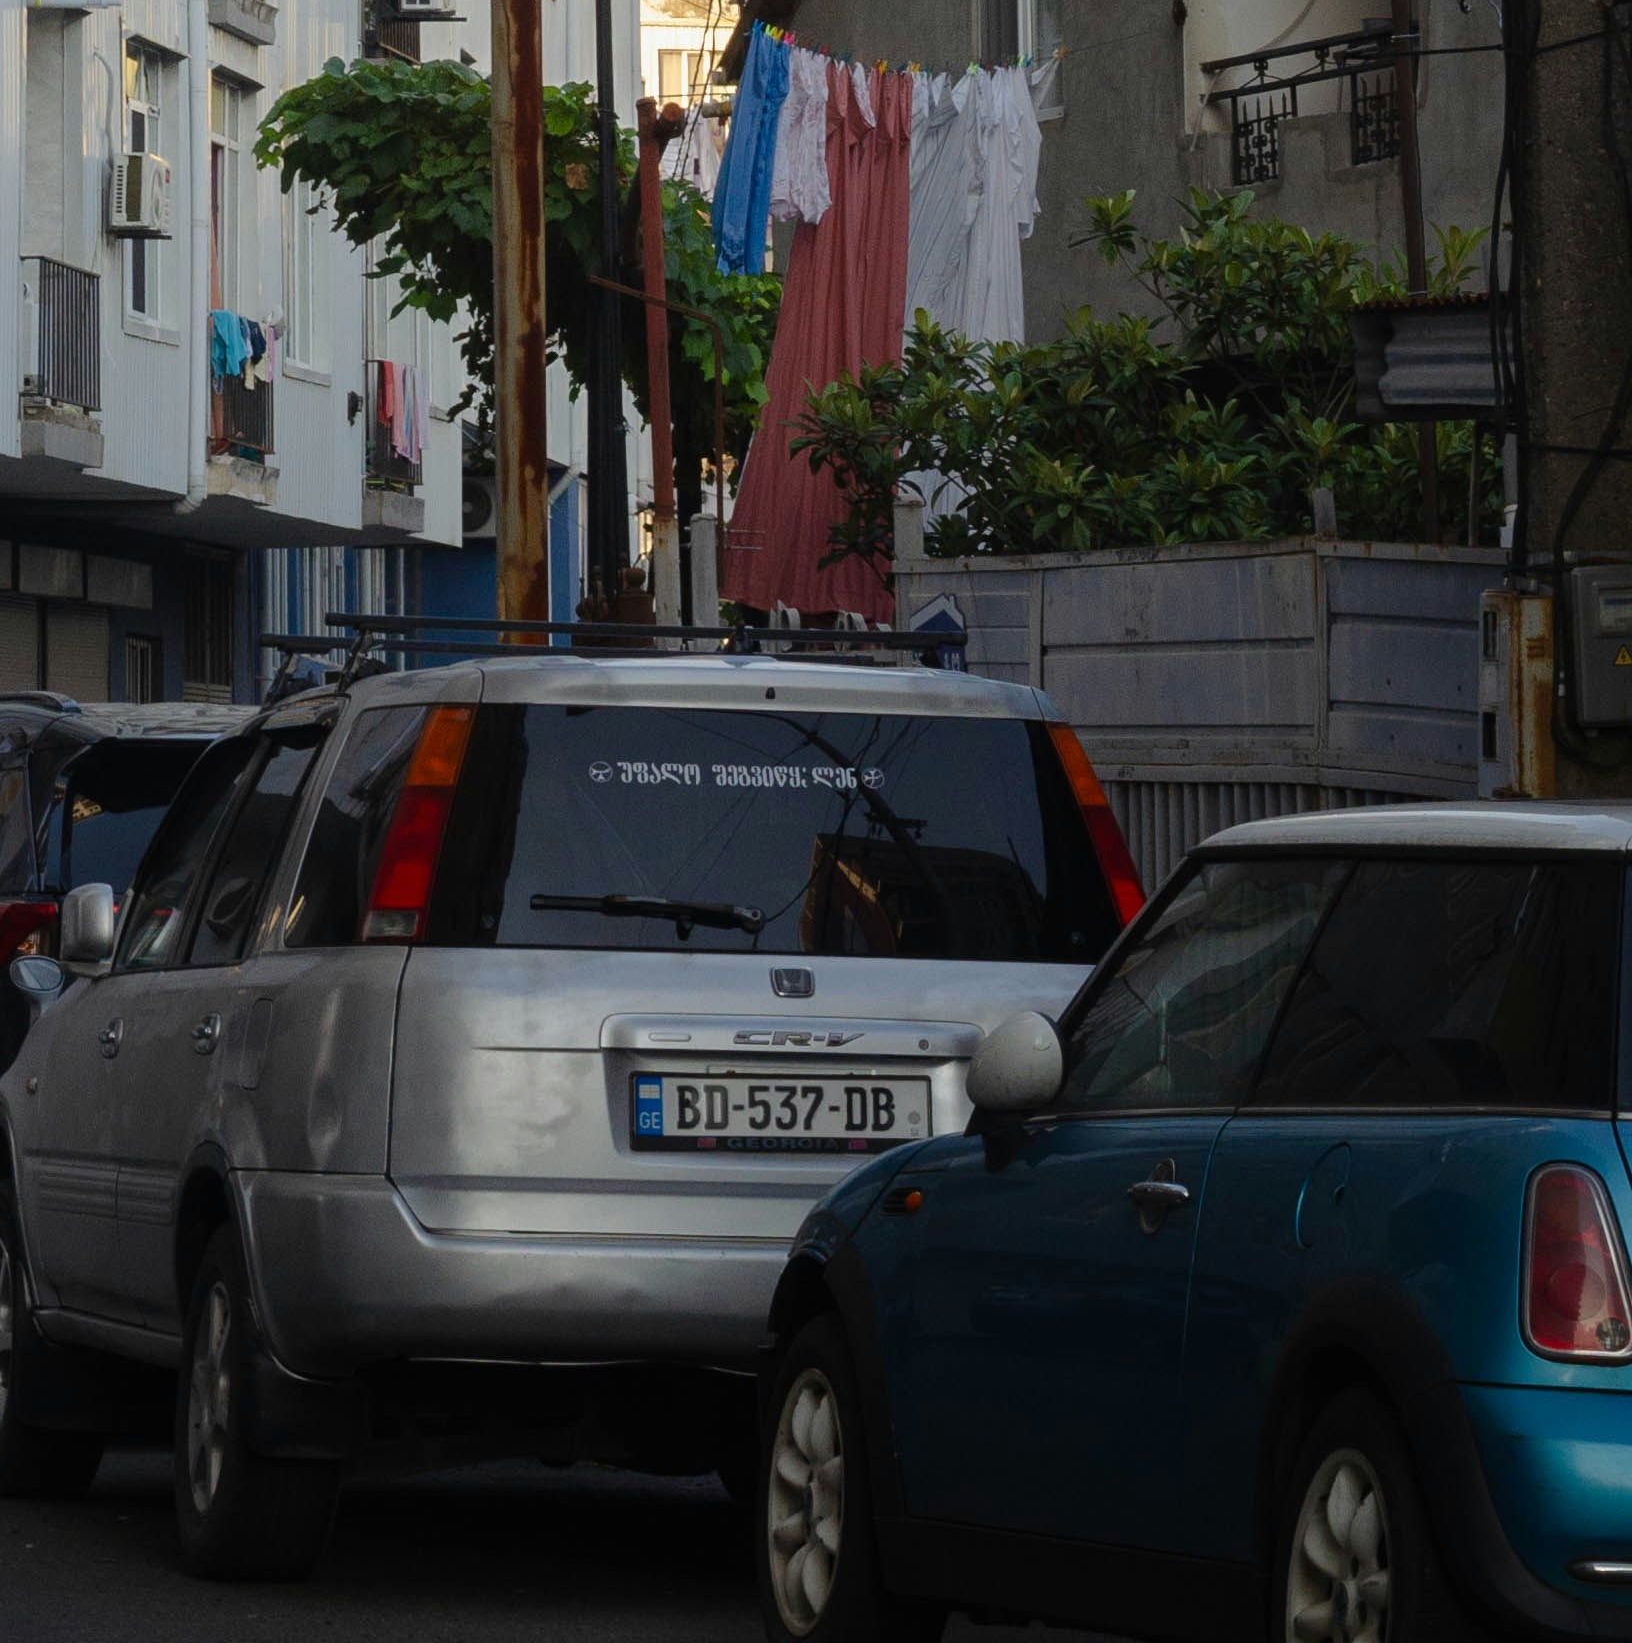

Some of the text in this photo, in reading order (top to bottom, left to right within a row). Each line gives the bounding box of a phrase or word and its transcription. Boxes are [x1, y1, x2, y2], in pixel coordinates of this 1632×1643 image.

[617, 762, 701, 786] უფალო
[733, 1030, 865, 1047] CR-V
[676, 1085, 896, 1132] BD-537-DB
[639, 1111, 660, 1130] GE
[727, 1137, 839, 1150] GEORGIA
